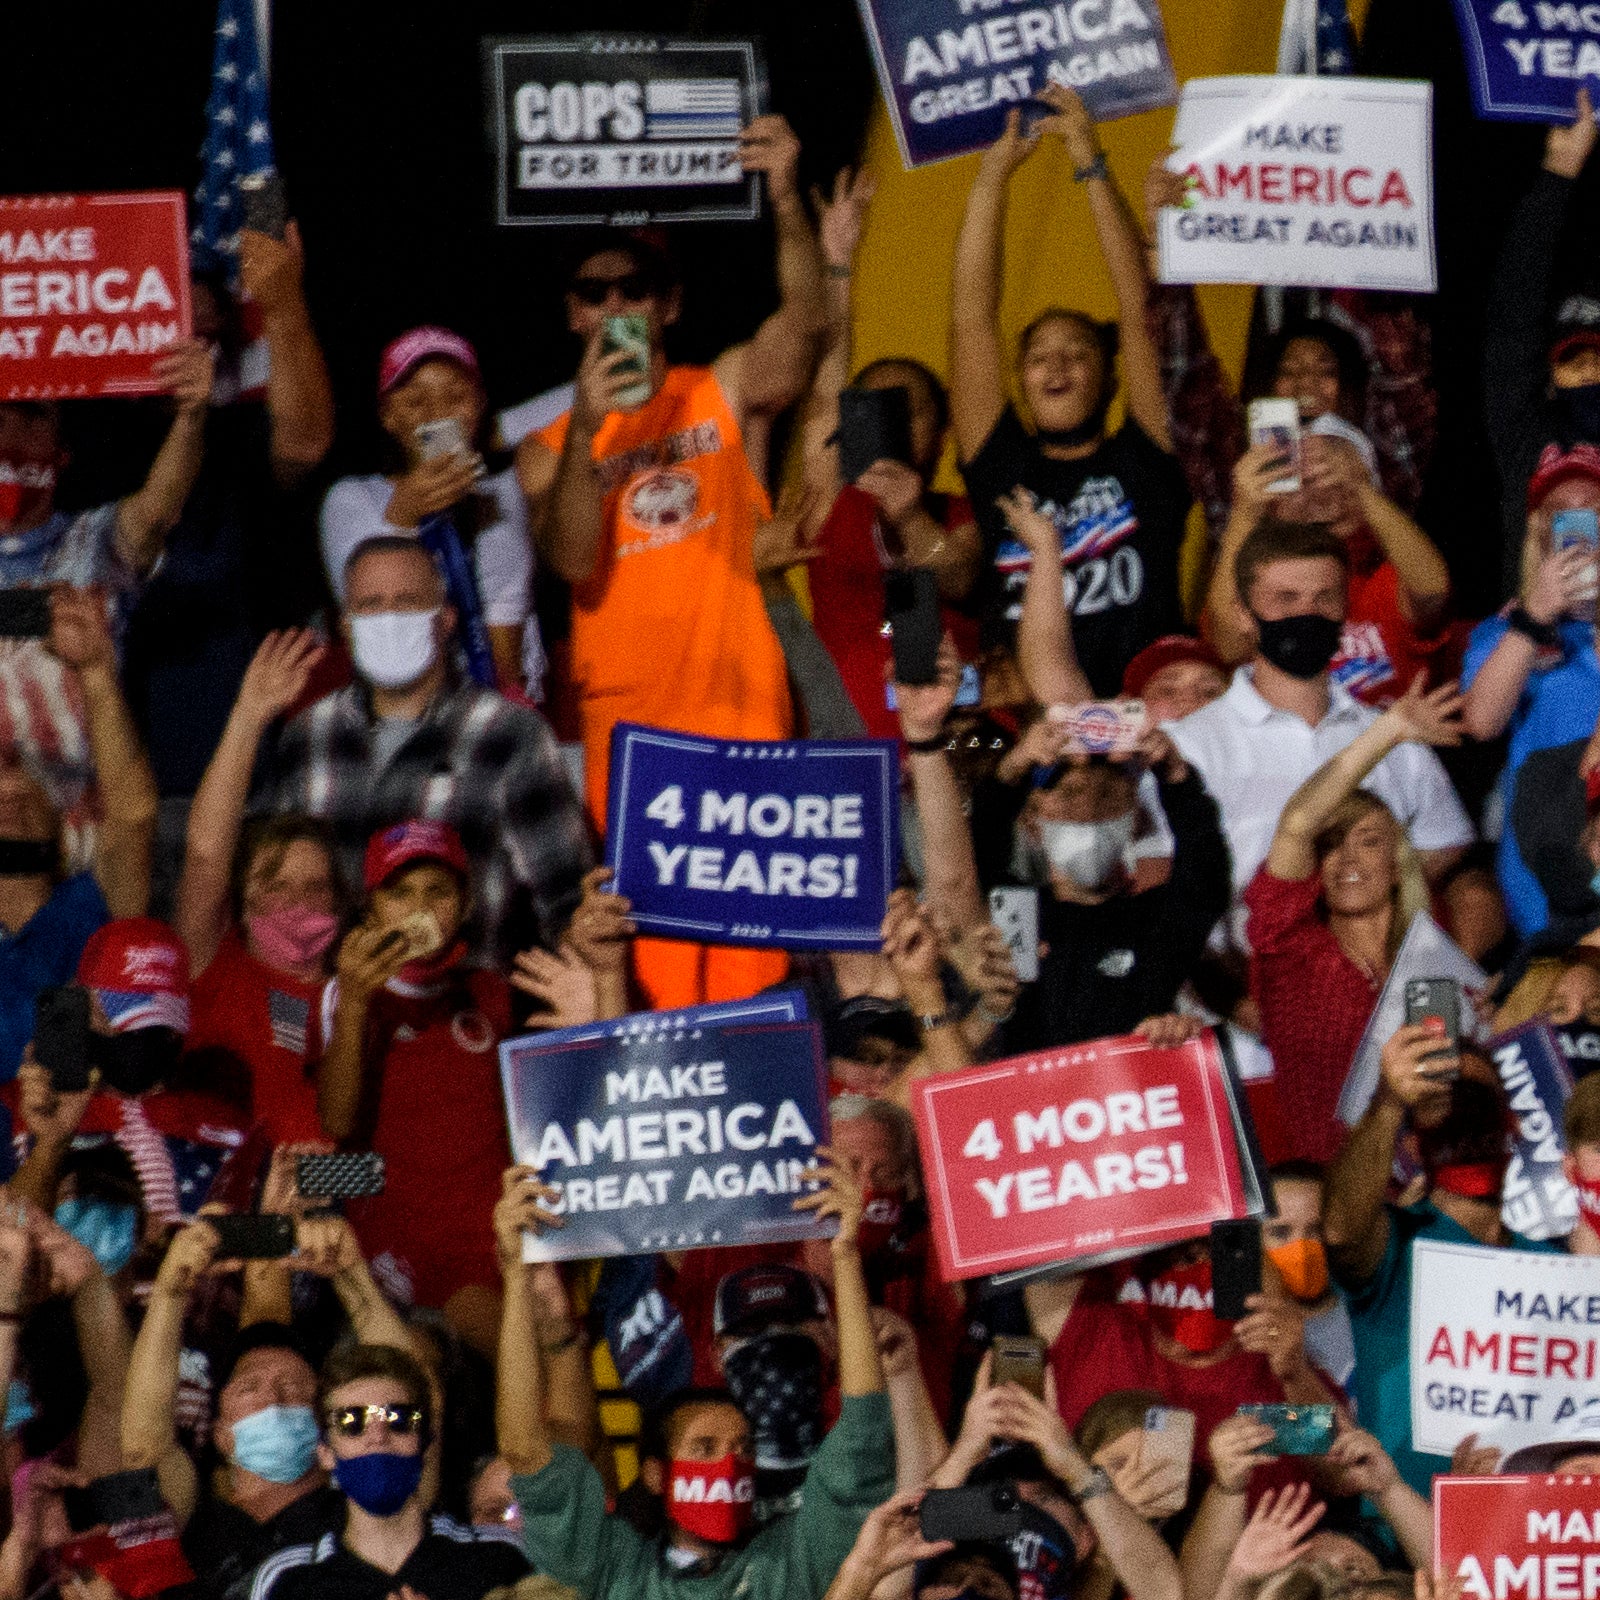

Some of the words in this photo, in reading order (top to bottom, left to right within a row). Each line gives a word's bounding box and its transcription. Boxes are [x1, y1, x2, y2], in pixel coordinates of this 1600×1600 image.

[1491, 0, 1530, 31] 4
[899, 2, 1151, 86] AMERICA
[516, 80, 647, 142] COPS
[910, 68, 1034, 126] GREAT
[1241, 122, 1344, 154] MAKE
[527, 153, 603, 180] FOR
[614, 152, 736, 180] TRUMP
[1178, 212, 1292, 244] GREAT
[1305, 214, 1420, 251] AGAIN
[645, 793, 684, 830] 4
[700, 793, 865, 840] MORE
[646, 844, 858, 898] YEARS!
[606, 1061, 728, 1104] MAKE
[535, 1098, 812, 1168] AMERICA
[962, 1117, 1004, 1163] 4
[1016, 1084, 1184, 1152] MORE
[537, 1168, 676, 1217] GREAT
[685, 1161, 809, 1202] AGAIN
[975, 1144, 1190, 1221] YEARS!
[1425, 1382, 1539, 1422] GREAT
